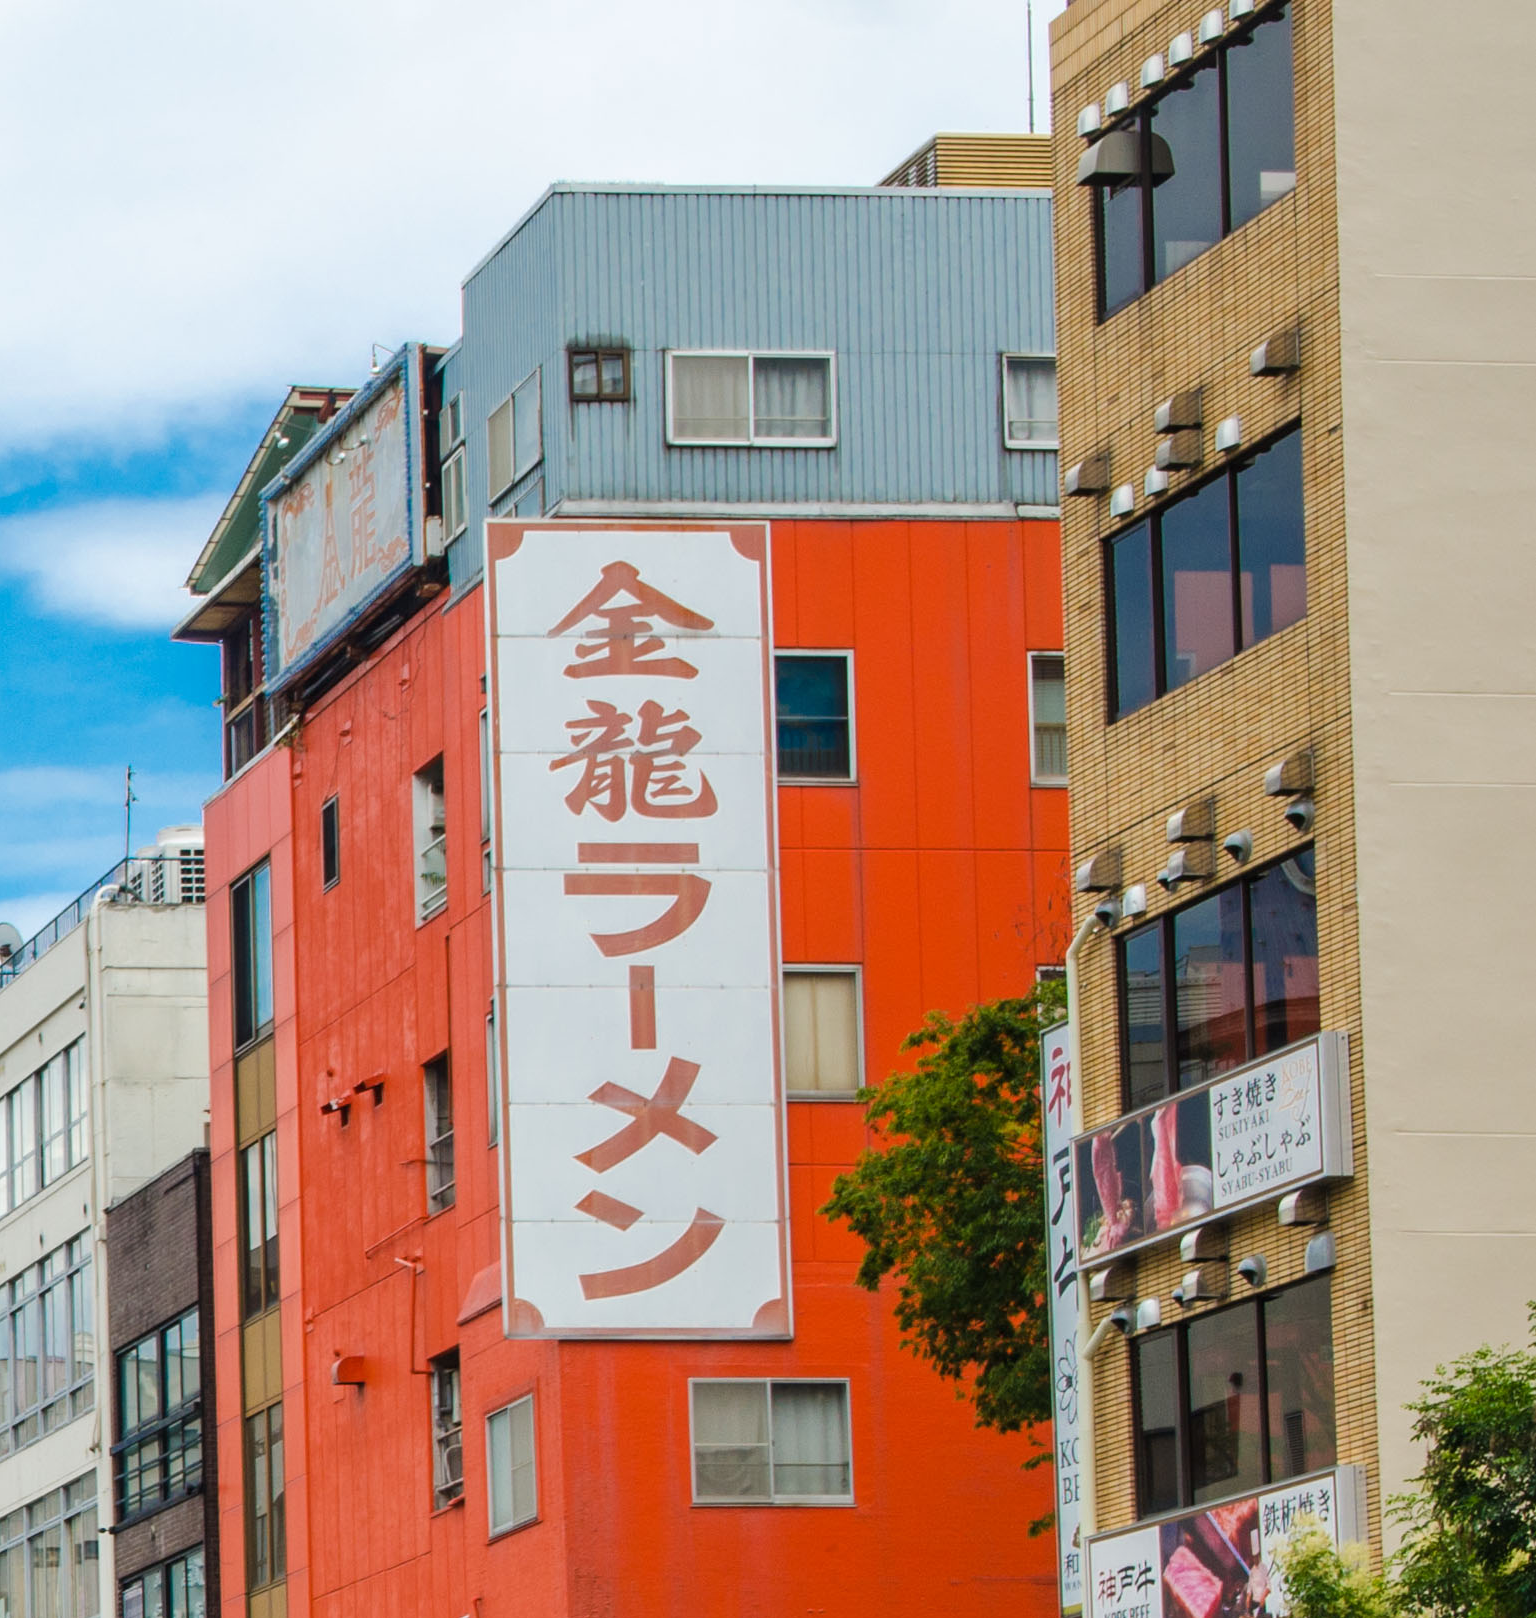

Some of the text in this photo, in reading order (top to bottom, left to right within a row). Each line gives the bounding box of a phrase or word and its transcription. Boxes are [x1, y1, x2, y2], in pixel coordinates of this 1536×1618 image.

[546, 560, 727, 1301] 金龍ラーメン
[1213, 1073, 1276, 1124] すき焼き
[1217, 1114, 1311, 1178] しゃぶしゃぶ
[1218, 1109, 1270, 1142] SUKIYAKI
[1221, 1157, 1294, 1198] SYABU-SYABU
[1098, 1560, 1155, 1608] 神戸牛
